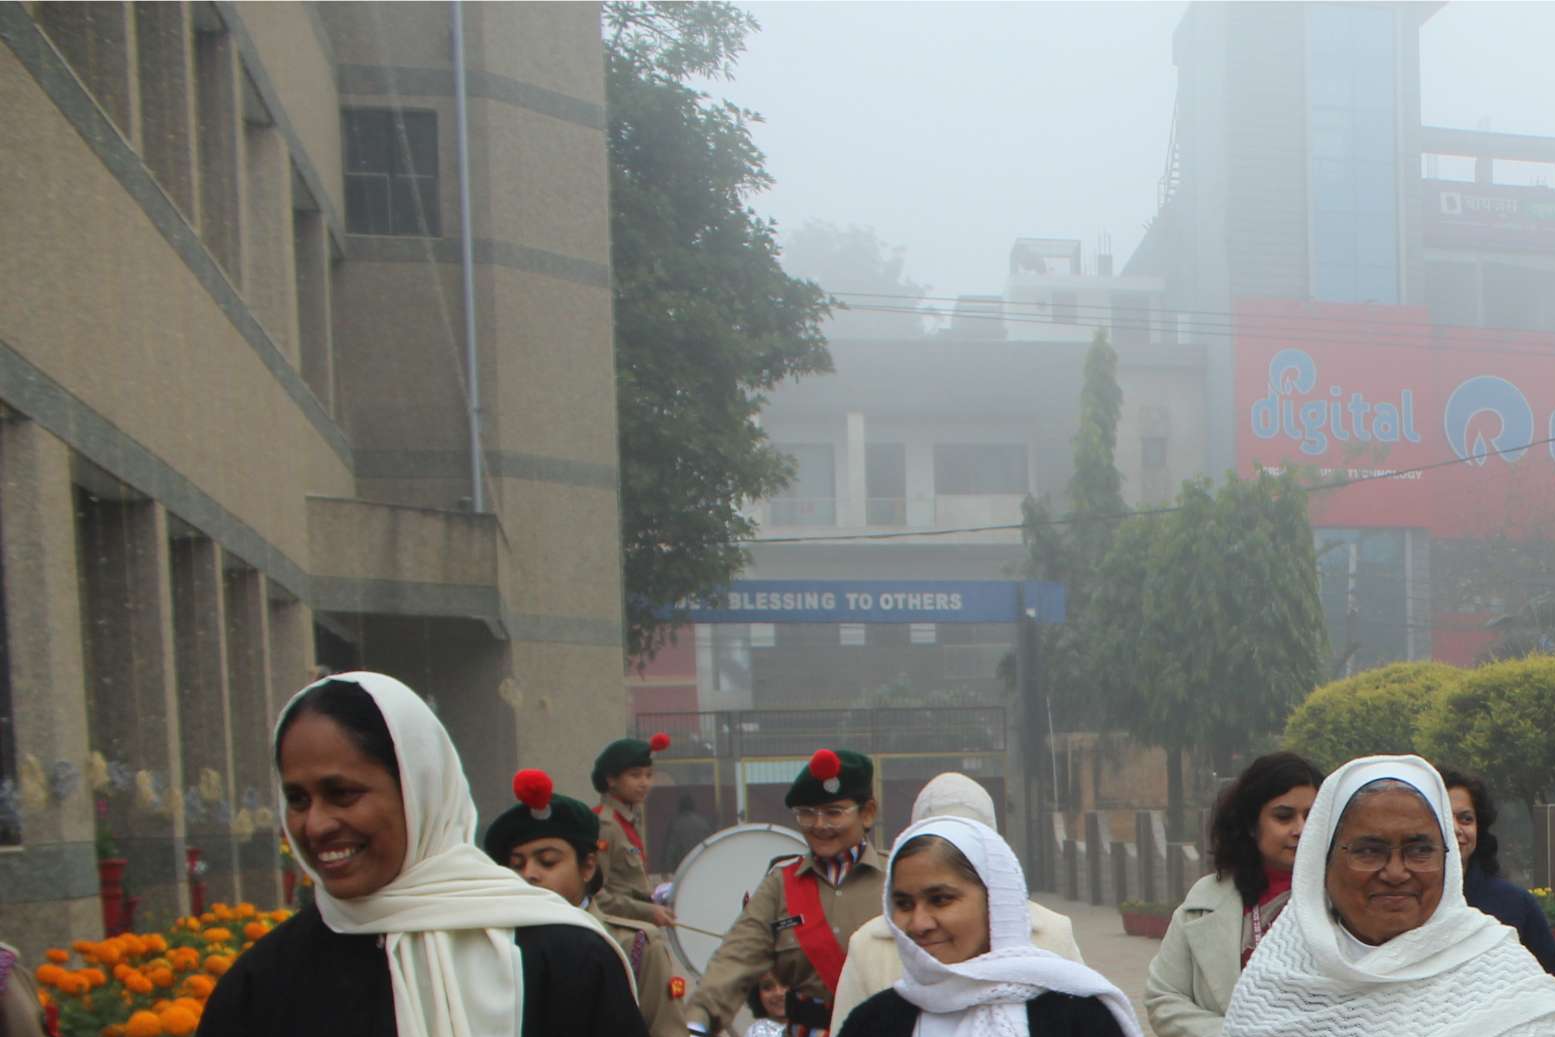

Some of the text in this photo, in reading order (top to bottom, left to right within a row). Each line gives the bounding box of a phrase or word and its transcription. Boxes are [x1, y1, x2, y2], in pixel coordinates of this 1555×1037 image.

[1251, 384, 1422, 456] digital
[728, 592, 837, 610] BLESSING
[845, 593, 873, 610] TO
[879, 592, 963, 610] OTHERS
